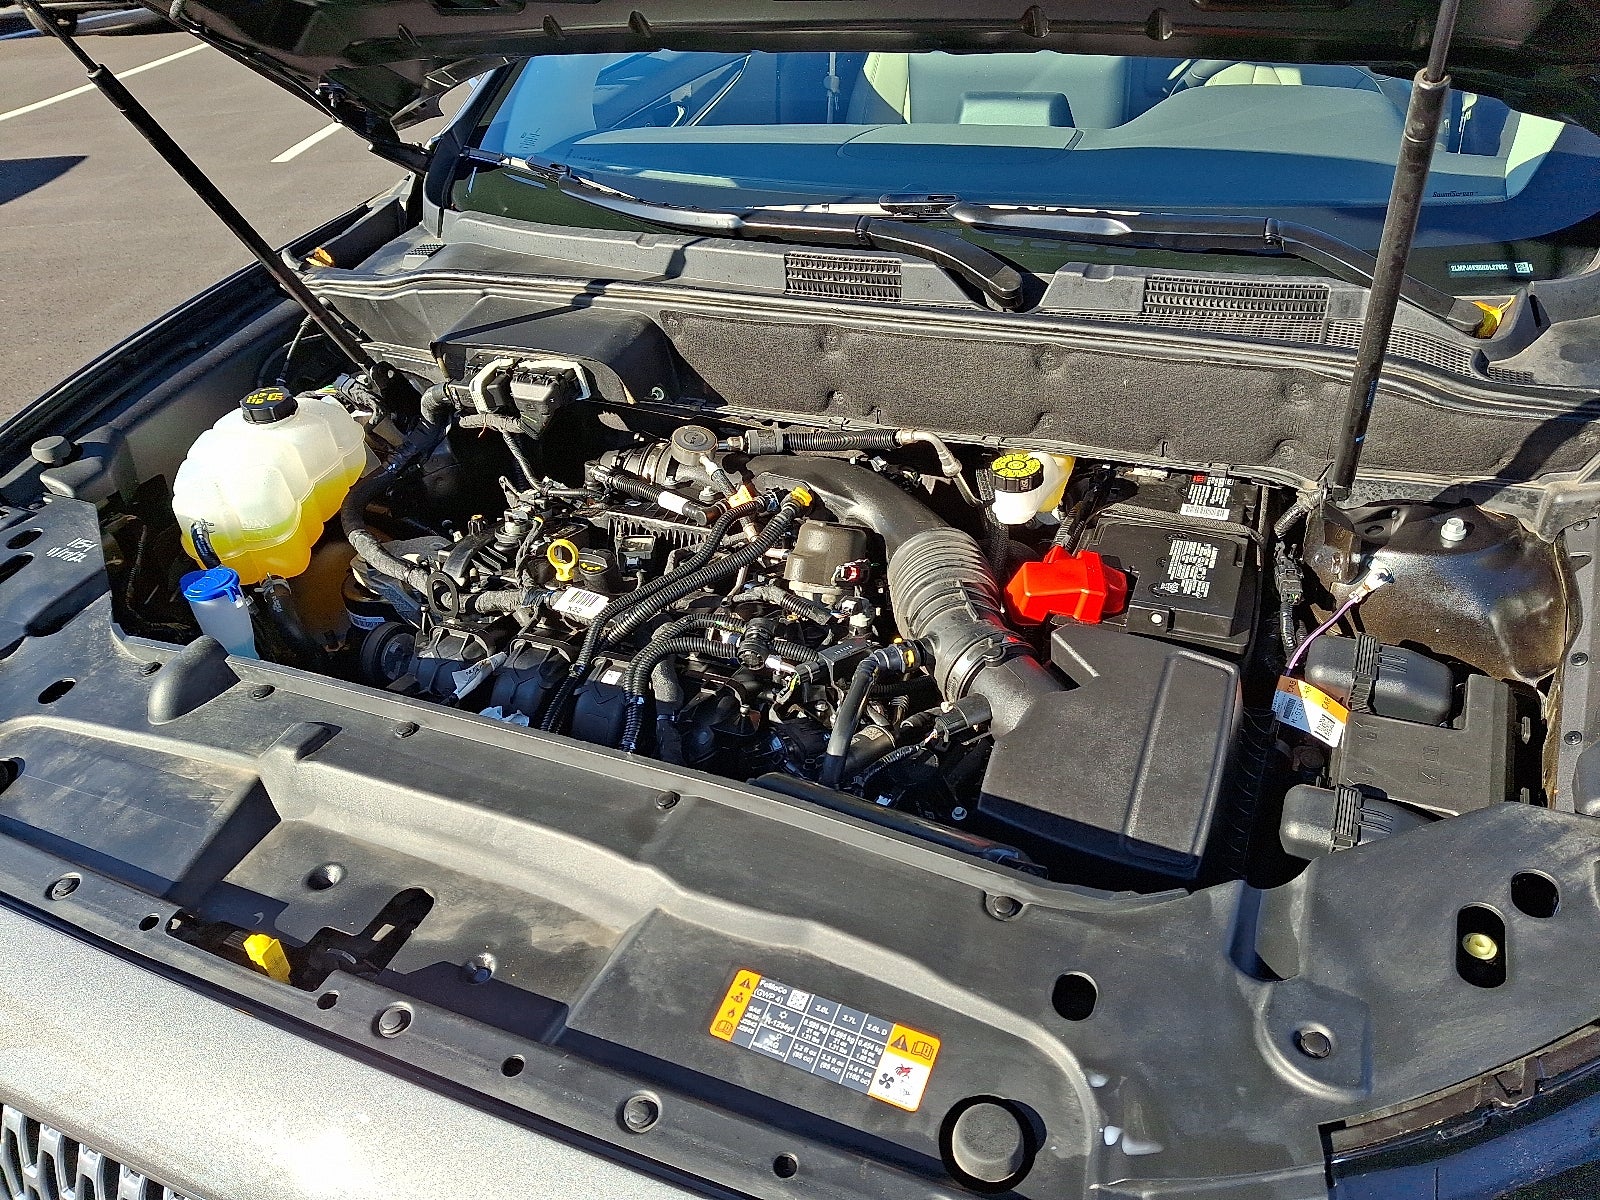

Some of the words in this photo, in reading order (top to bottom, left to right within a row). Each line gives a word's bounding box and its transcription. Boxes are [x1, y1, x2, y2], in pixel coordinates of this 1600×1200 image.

[1321, 696, 1332, 710] CAB
[753, 988, 775, 1000] (GWP
[759, 979, 788, 995] FoMoCo
